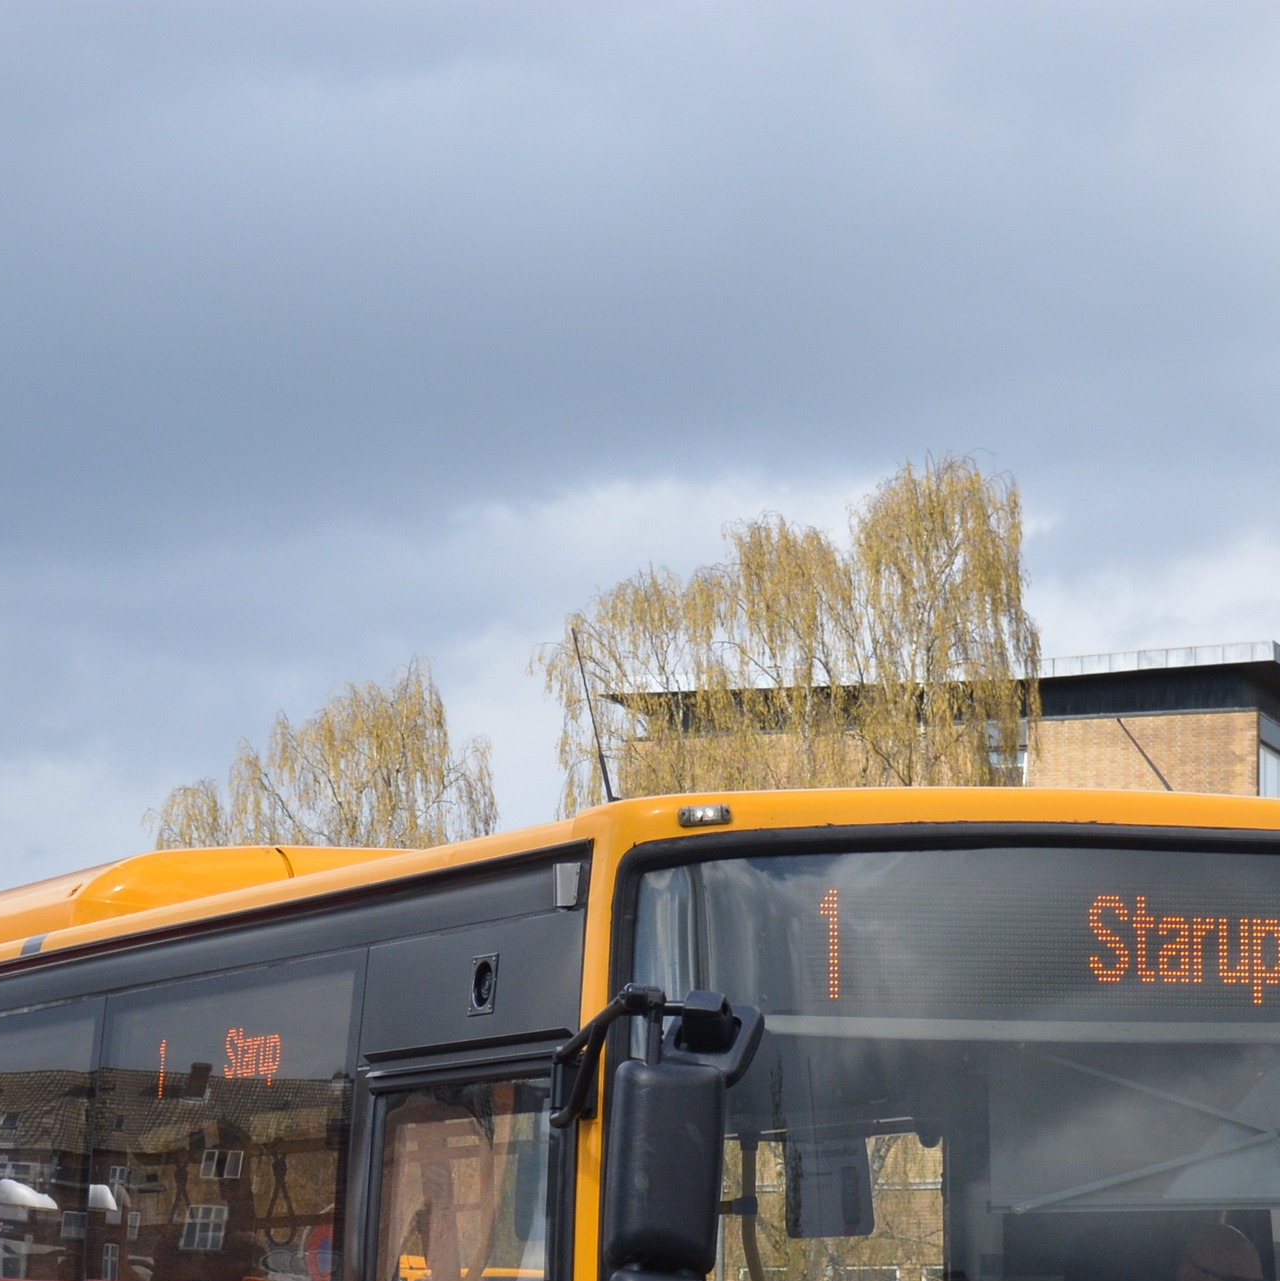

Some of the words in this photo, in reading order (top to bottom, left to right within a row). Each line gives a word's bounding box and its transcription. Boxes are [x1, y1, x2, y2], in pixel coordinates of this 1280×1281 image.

[819, 888, 839, 999] 1
[158, 1038, 167, 1100] 1
[223, 1027, 281, 1087] Starup
